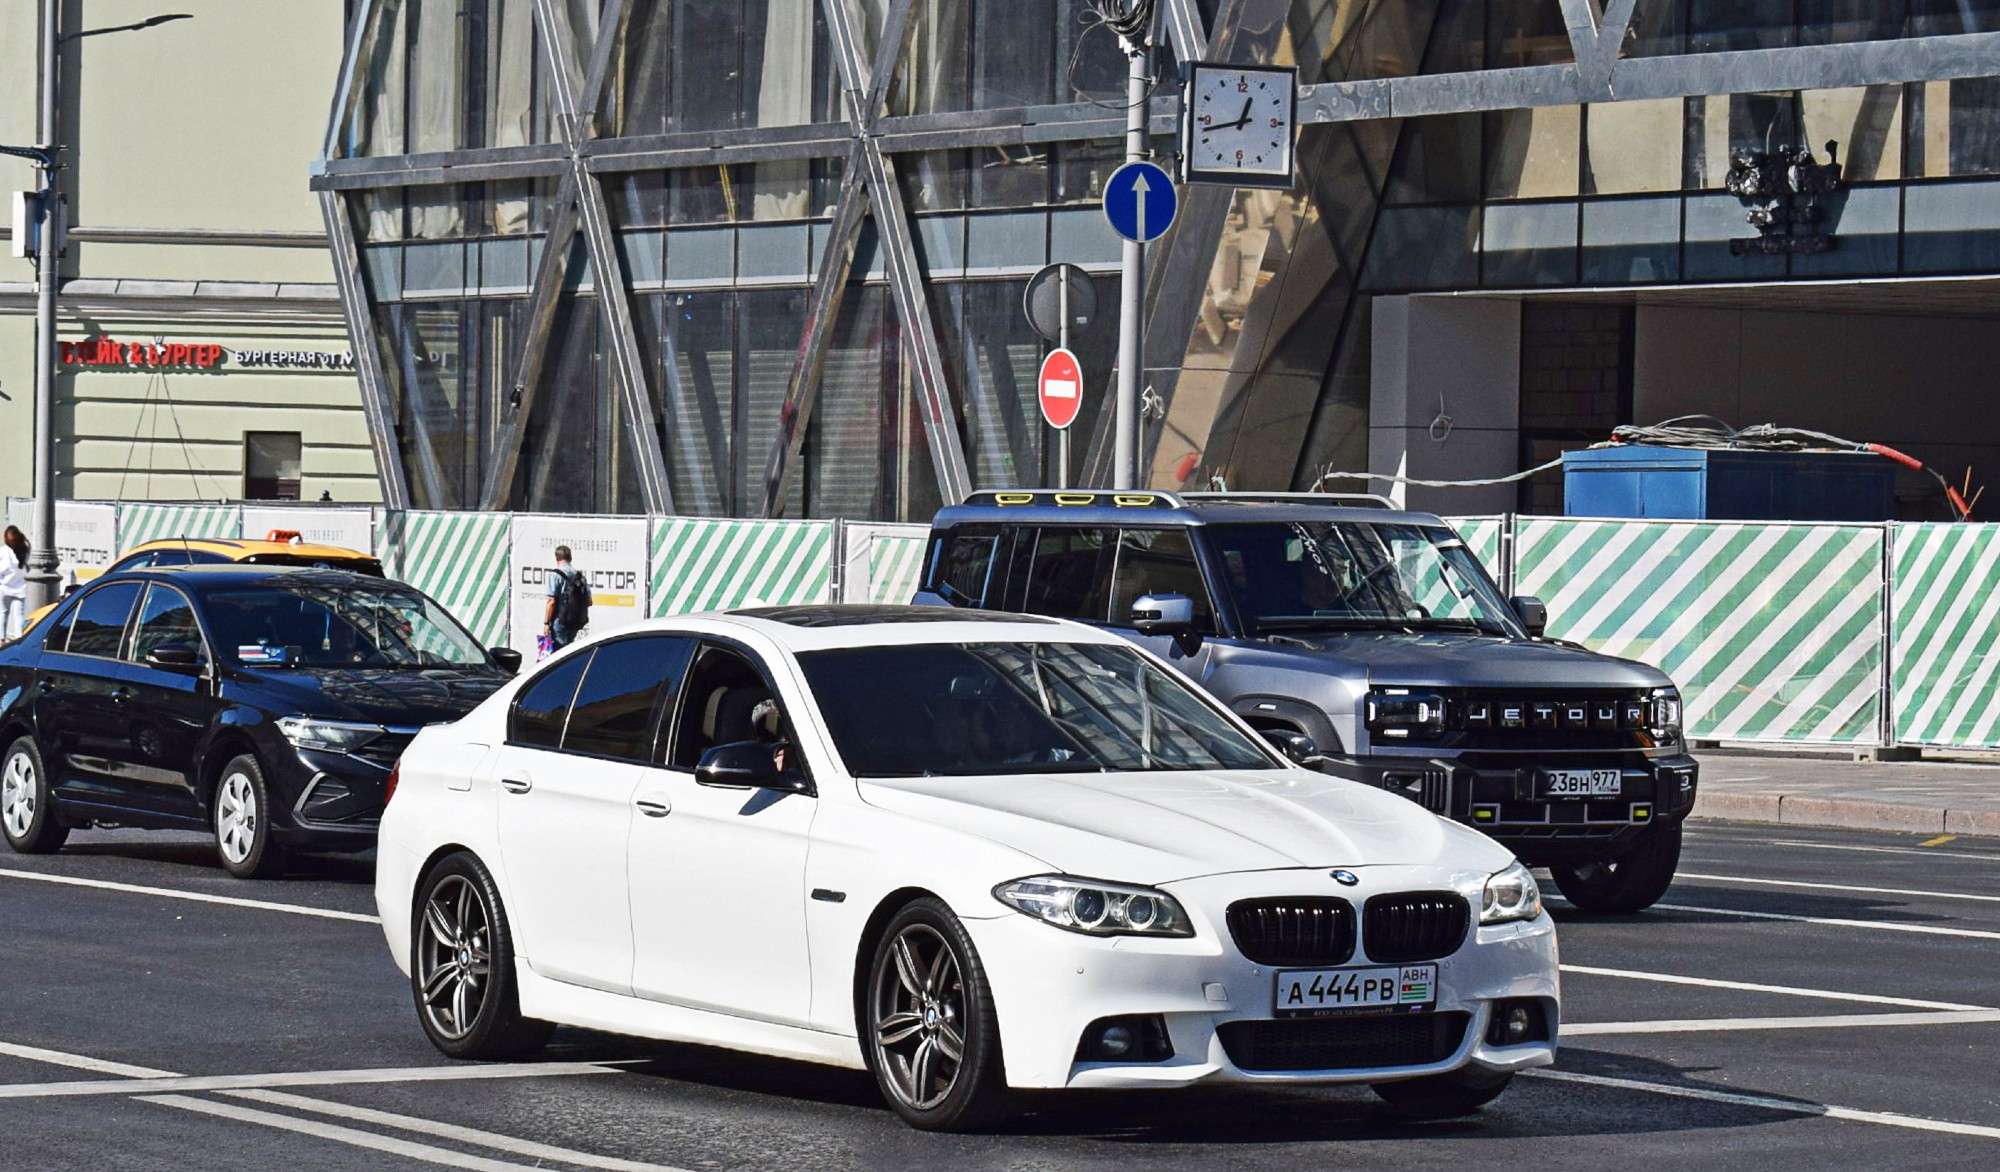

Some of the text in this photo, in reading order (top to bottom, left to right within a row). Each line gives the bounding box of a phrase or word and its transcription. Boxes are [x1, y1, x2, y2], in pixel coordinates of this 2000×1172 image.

[1236, 83, 1248, 92] 12
[1203, 115, 1211, 125] 9
[1270, 118, 1278, 128] 3
[1236, 150, 1243, 160] 6
[130, 342, 143, 365] &
[235, 351, 316, 363] БУРГЕРНАЯ
[57, 547, 108, 565] STRUCTOR
[522, 567, 636, 590] CONUCTOR
[1469, 708, 1641, 720] JETOUR
[1593, 771, 1617, 786] 977
[1402, 968, 1429, 981] ABH
